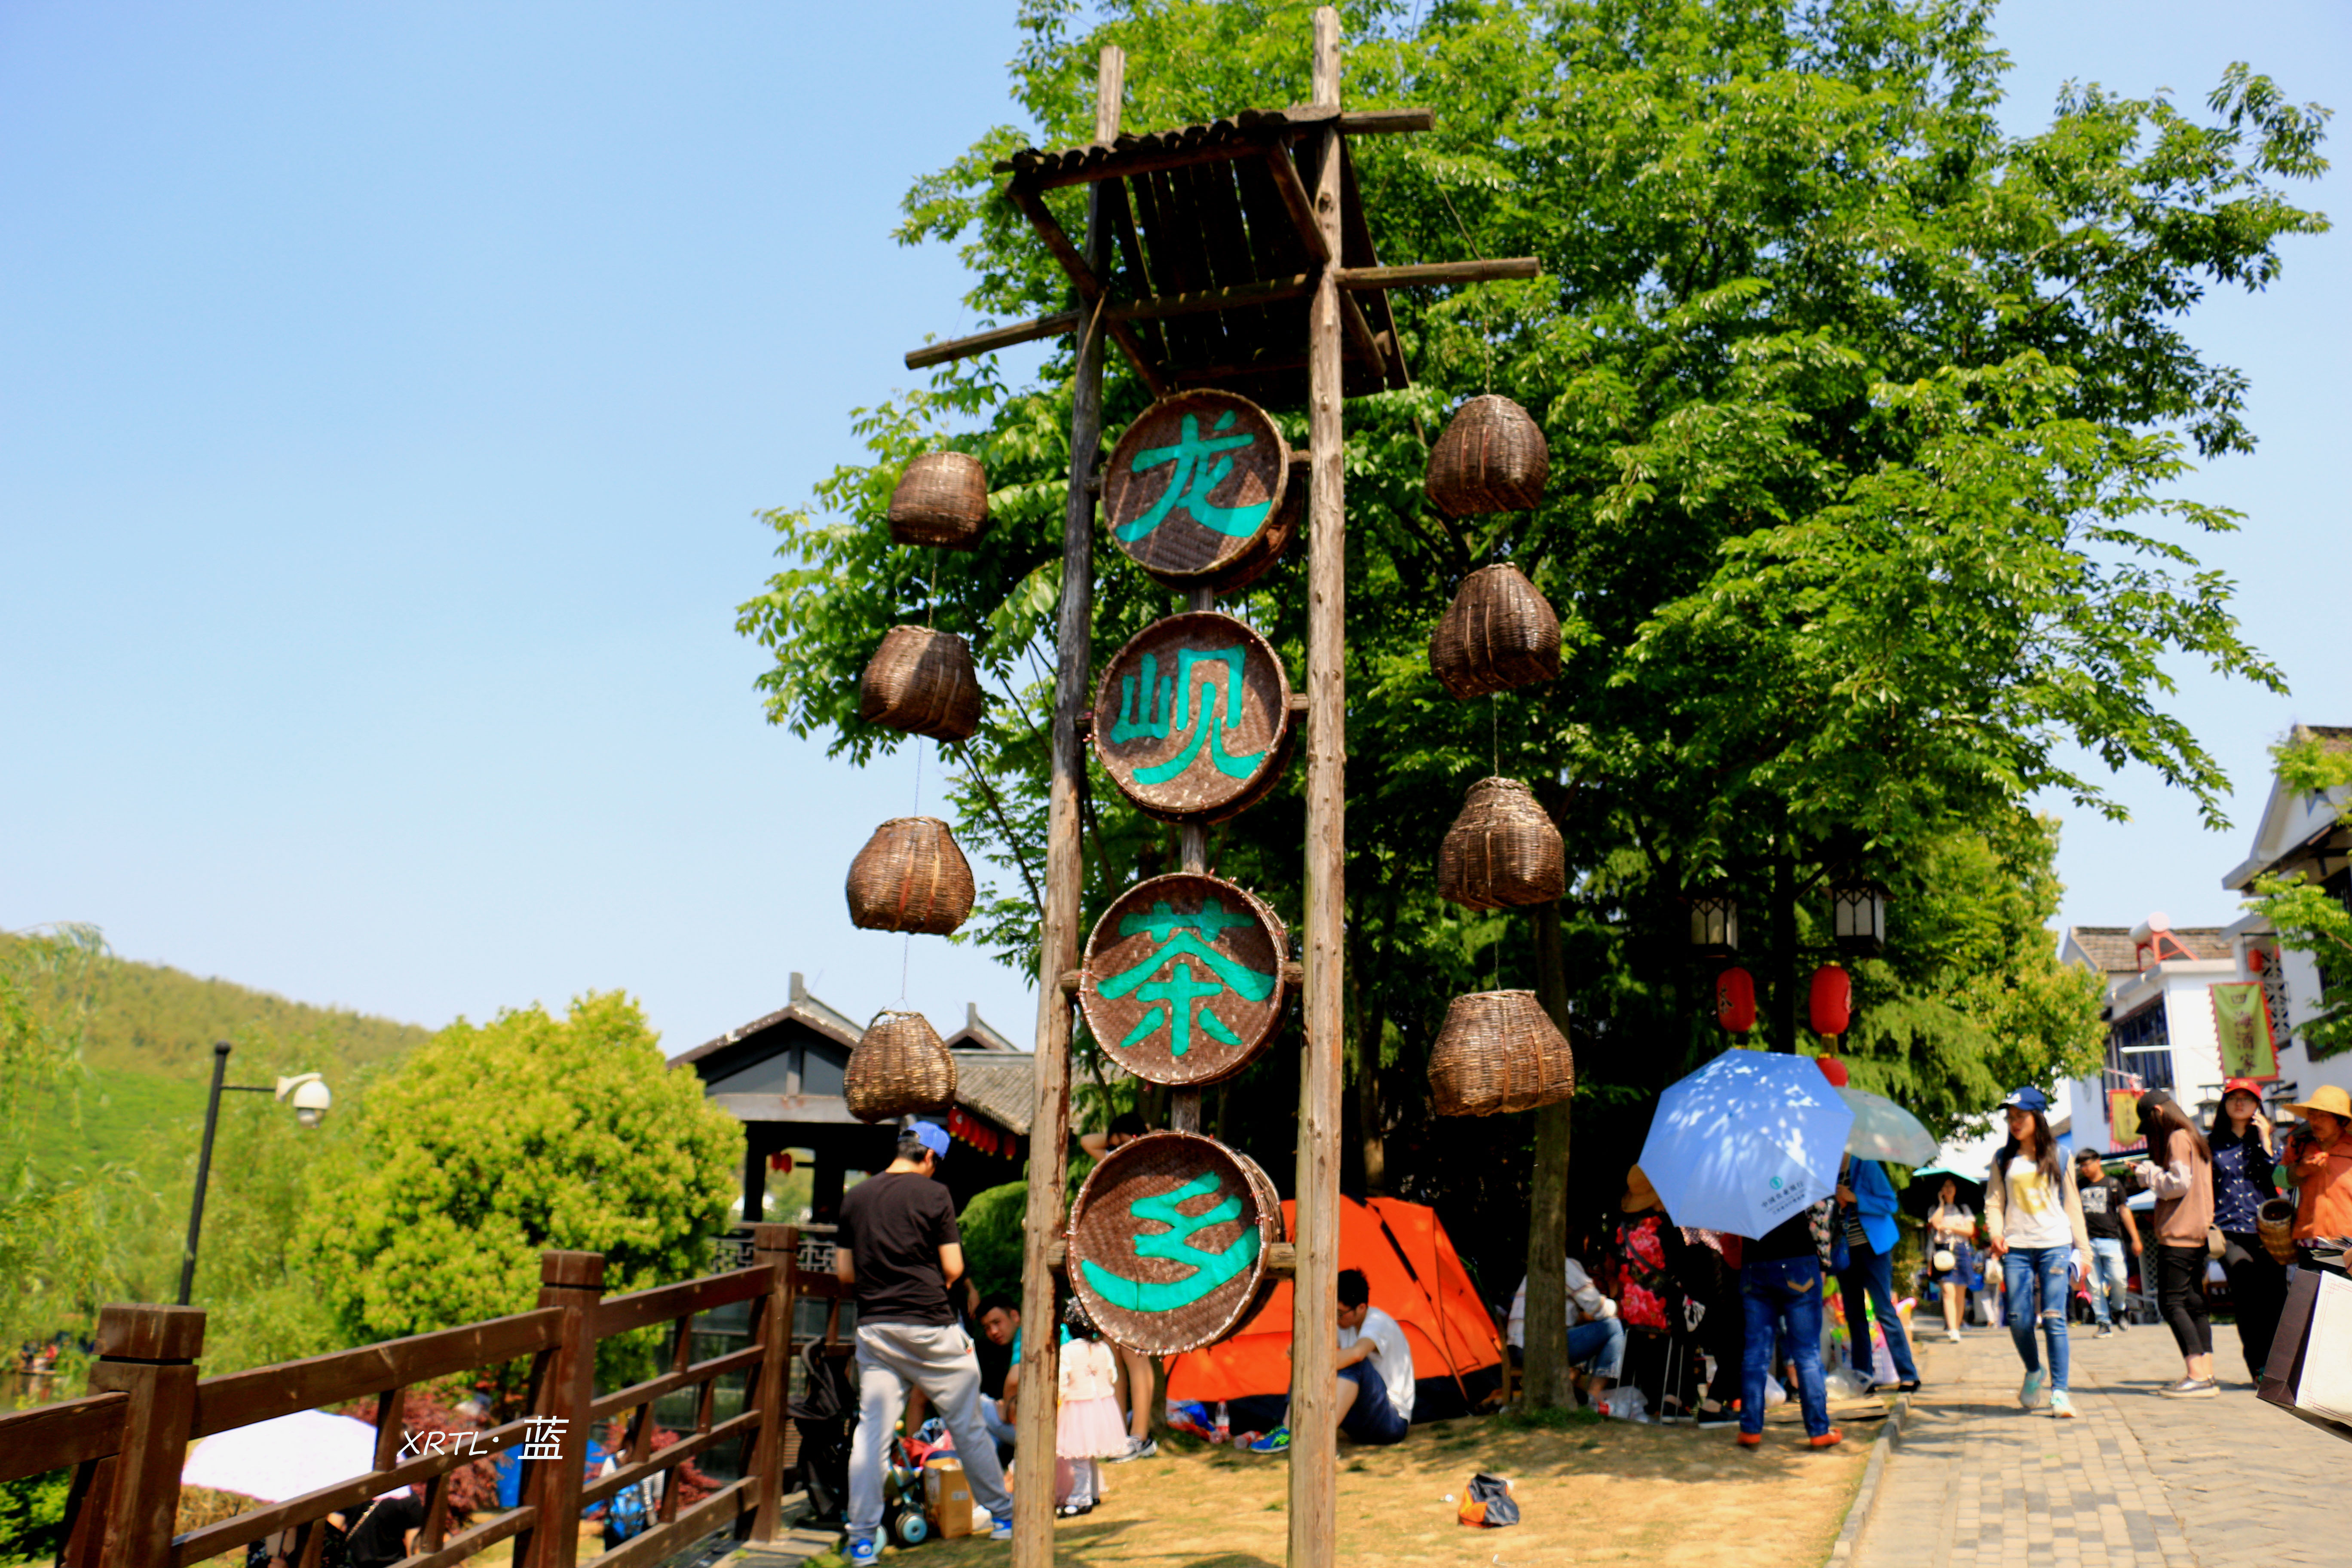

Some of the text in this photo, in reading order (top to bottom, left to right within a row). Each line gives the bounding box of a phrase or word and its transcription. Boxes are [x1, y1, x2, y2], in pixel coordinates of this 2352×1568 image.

[1081, 410, 1274, 1312] 龙岘茶乡
[2231, 994, 2256, 1072] 四海酒家
